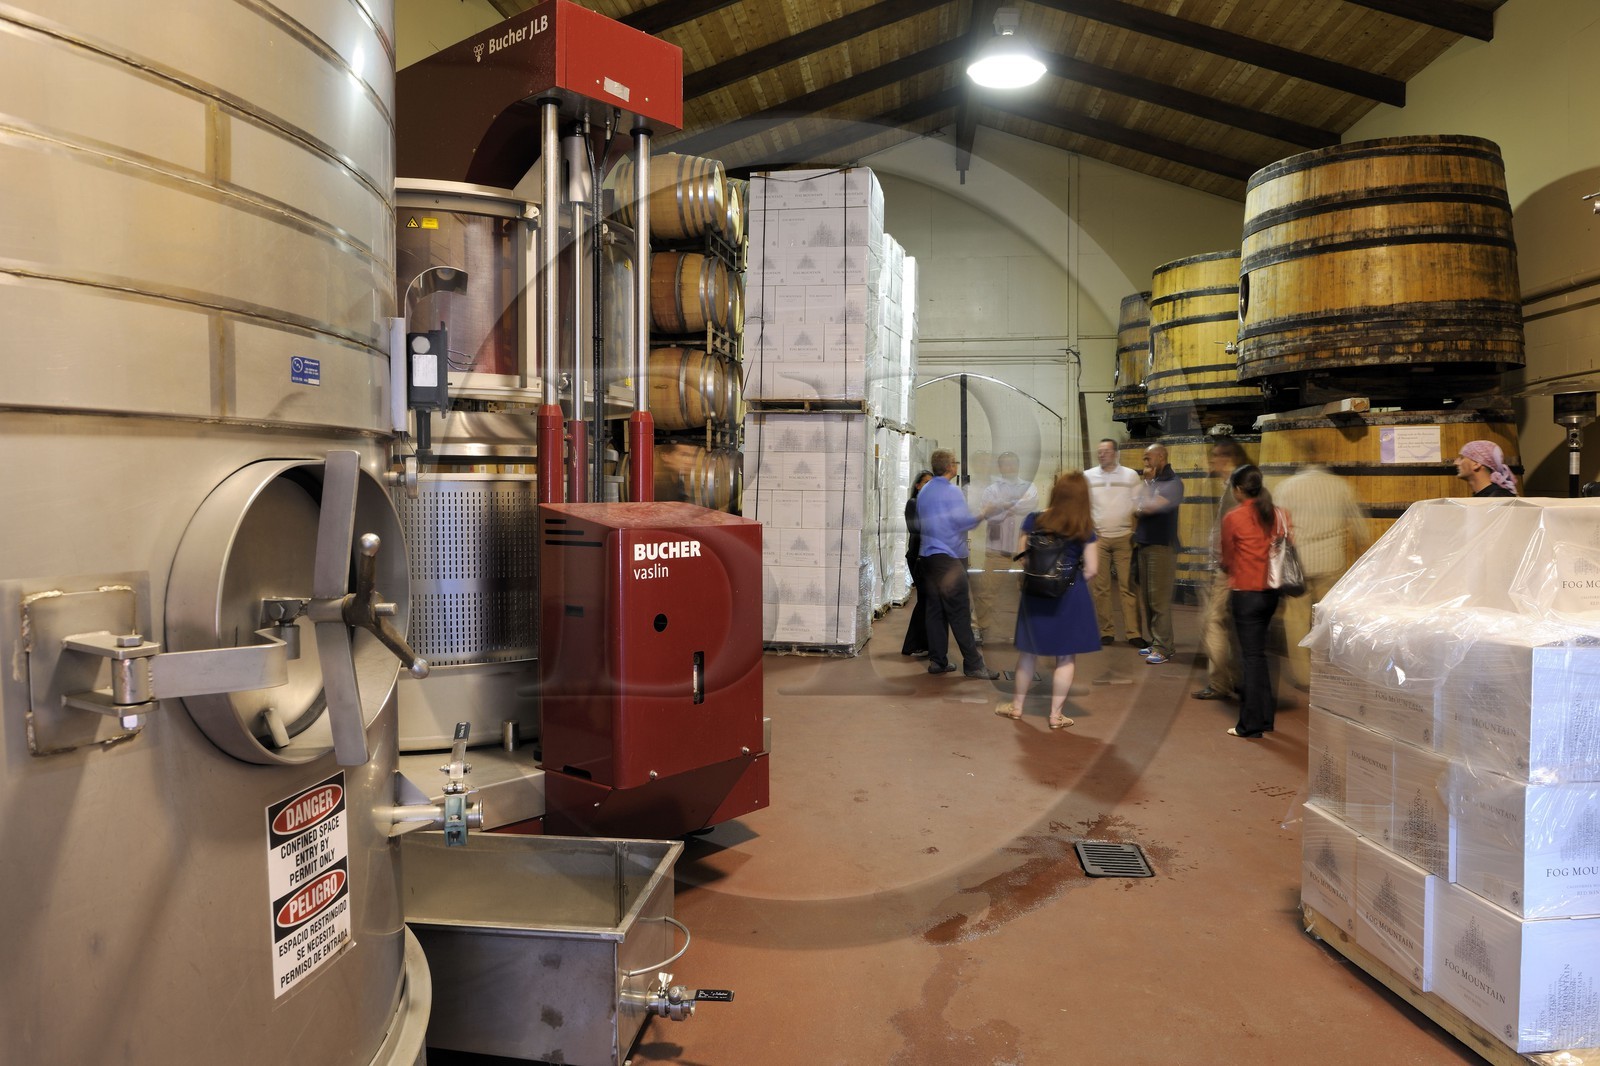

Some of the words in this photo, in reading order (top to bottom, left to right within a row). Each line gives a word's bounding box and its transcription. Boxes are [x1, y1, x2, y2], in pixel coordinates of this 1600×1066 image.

[489, 25, 527, 54] Bucher
[529, 14, 549, 40] JLB
[634, 541, 701, 561] BUCHER
[634, 563, 669, 580] vaslin
[1562, 580, 1583, 589] FOG
[1585, 580, 1600, 589] MO
[1472, 718, 1517, 737] MOUNTAIN
[1351, 750, 1362, 760] FOG
[1361, 755, 1388, 771] MOUNTAIN
[286, 788, 334, 830] DANGER
[281, 831, 318, 859] CONFINED
[319, 816, 340, 841] SPACE
[296, 843, 319, 868] ENTRY
[321, 837, 330, 853] BY
[289, 860, 318, 887] PERMIT
[319, 848, 336, 871] ONLY
[1546, 868, 1569, 878] FOG
[1572, 866, 1600, 876] MOU
[289, 873, 338, 924] PELIGRO
[279, 929, 309, 958] ESPACIO
[310, 904, 347, 937] RESTRINGIDO
[296, 947, 307, 961] SE
[307, 928, 336, 953] NECESITA
[1365, 911, 1378, 925] FOG
[1379, 921, 1415, 950] MOUNTAIN
[280, 956, 313, 989] PERMISO
[313, 949, 322, 963] DE
[323, 929, 348, 955] ENTRADA
[1444, 958, 1460, 974] FOG
[1461, 969, 1506, 1004] MOUNTAIN
